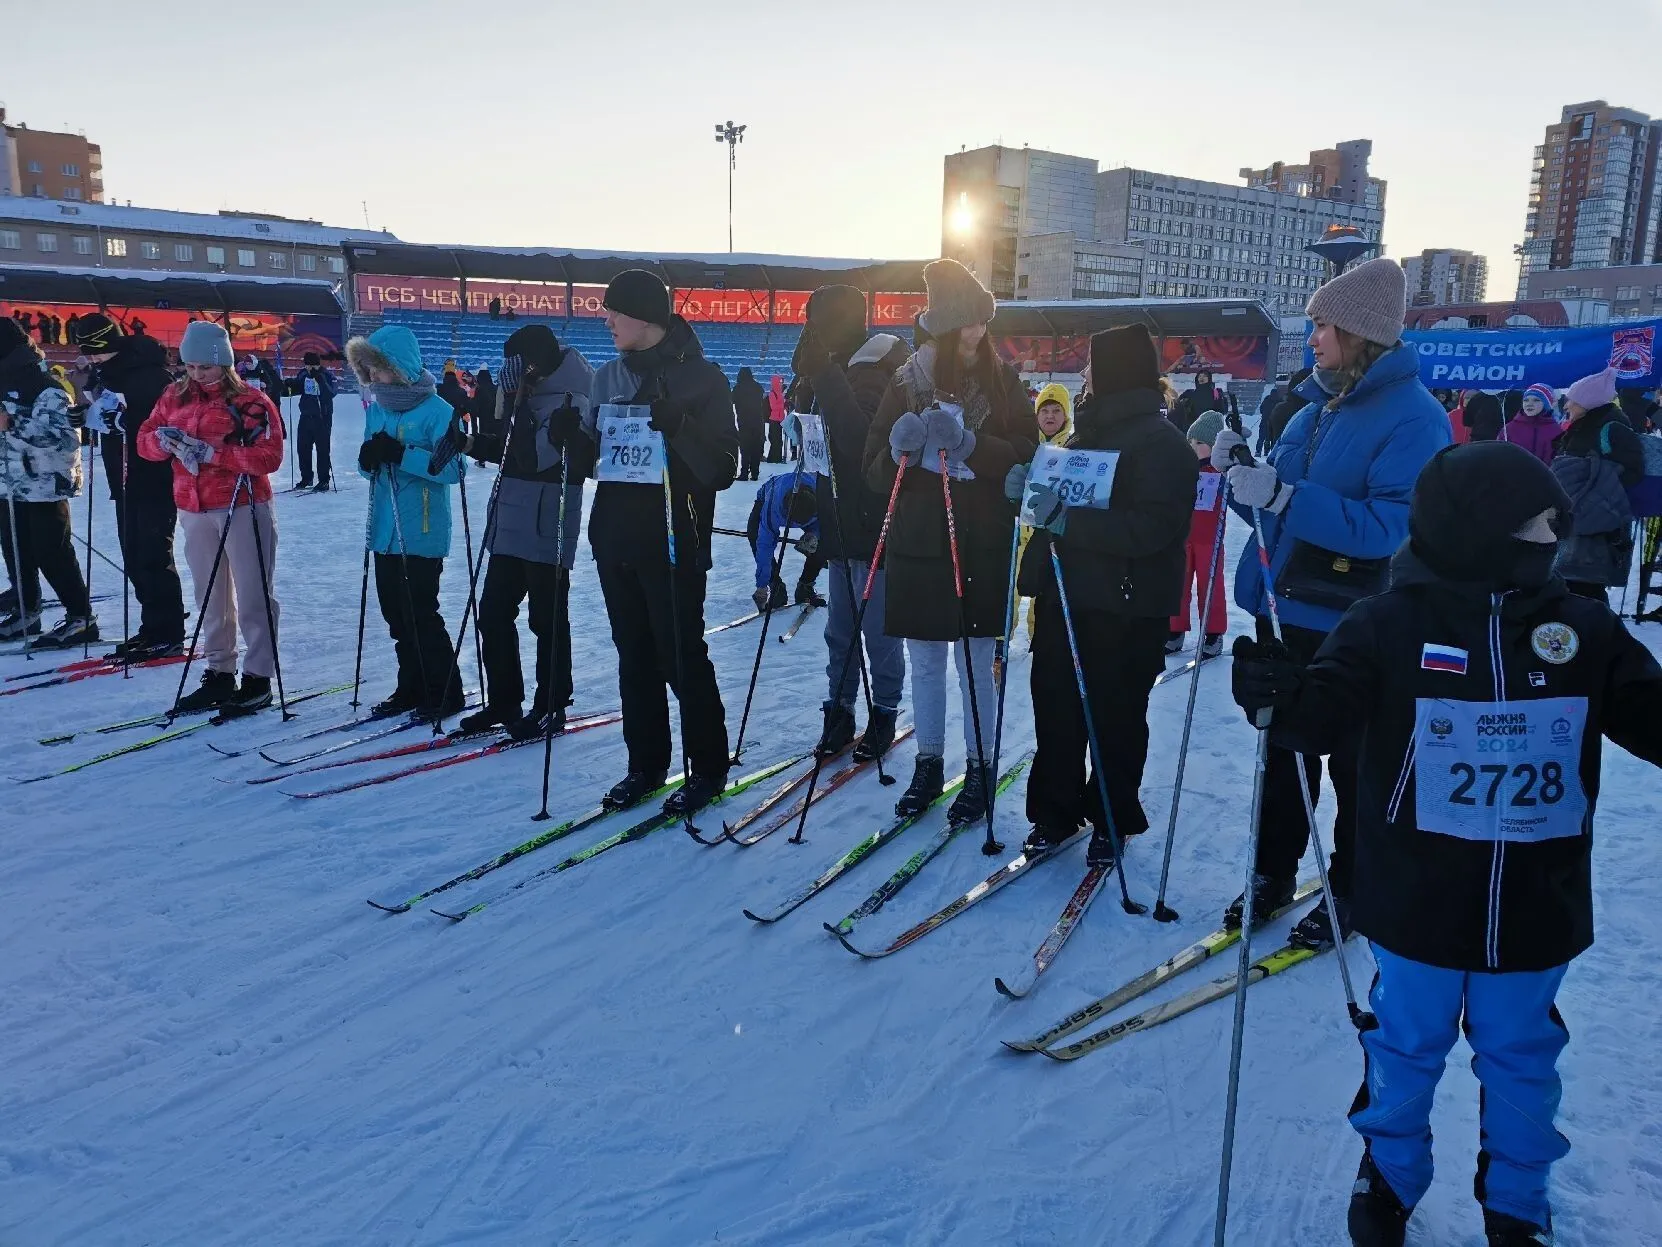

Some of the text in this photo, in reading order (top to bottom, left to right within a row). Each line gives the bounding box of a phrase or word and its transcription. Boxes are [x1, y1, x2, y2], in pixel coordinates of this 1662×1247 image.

[367, 285, 415, 303] ПСБ
[422, 288, 564, 310] ЧЕМПИОНАТ
[672, 300, 702, 315] ПО
[709, 299, 791, 317] ЛЕГКОЙ
[1419, 339, 1562, 357] ОВЕТСКИЙ
[1433, 364, 1525, 381] РАЙОН
[611, 445, 652, 467] 7692
[1048, 476, 1097, 503] 7694
[1476, 713, 1527, 725] ЛЫЖНЯ
[1477, 724, 1527, 737] РОССИИ
[1477, 738, 1529, 753] 2024
[1448, 761, 1565, 807] 2728
[1500, 825, 1535, 834] ОБЛАСТЬ
